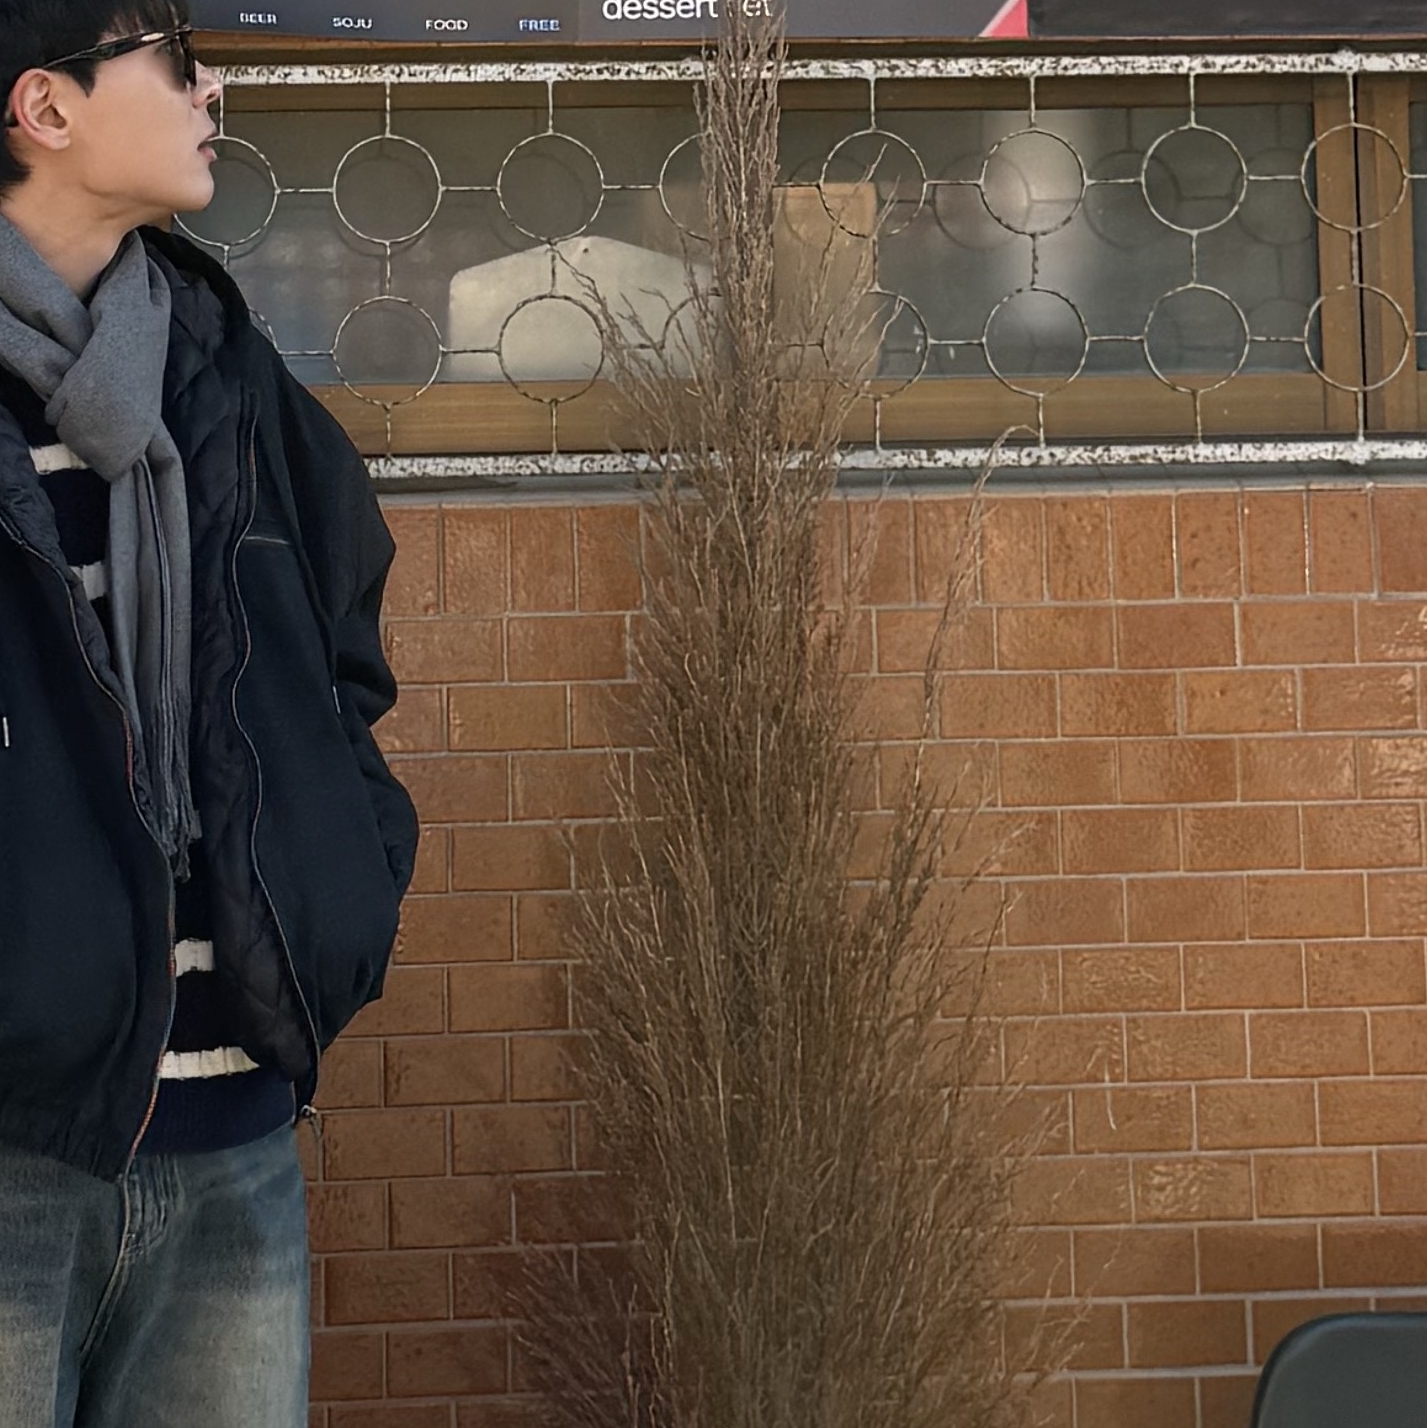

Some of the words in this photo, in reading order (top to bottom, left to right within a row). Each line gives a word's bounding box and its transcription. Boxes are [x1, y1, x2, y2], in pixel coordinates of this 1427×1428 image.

[332, 17, 373, 29] SOJU
[425, 19, 468, 31] FOOD
[519, 19, 560, 32] FREE
